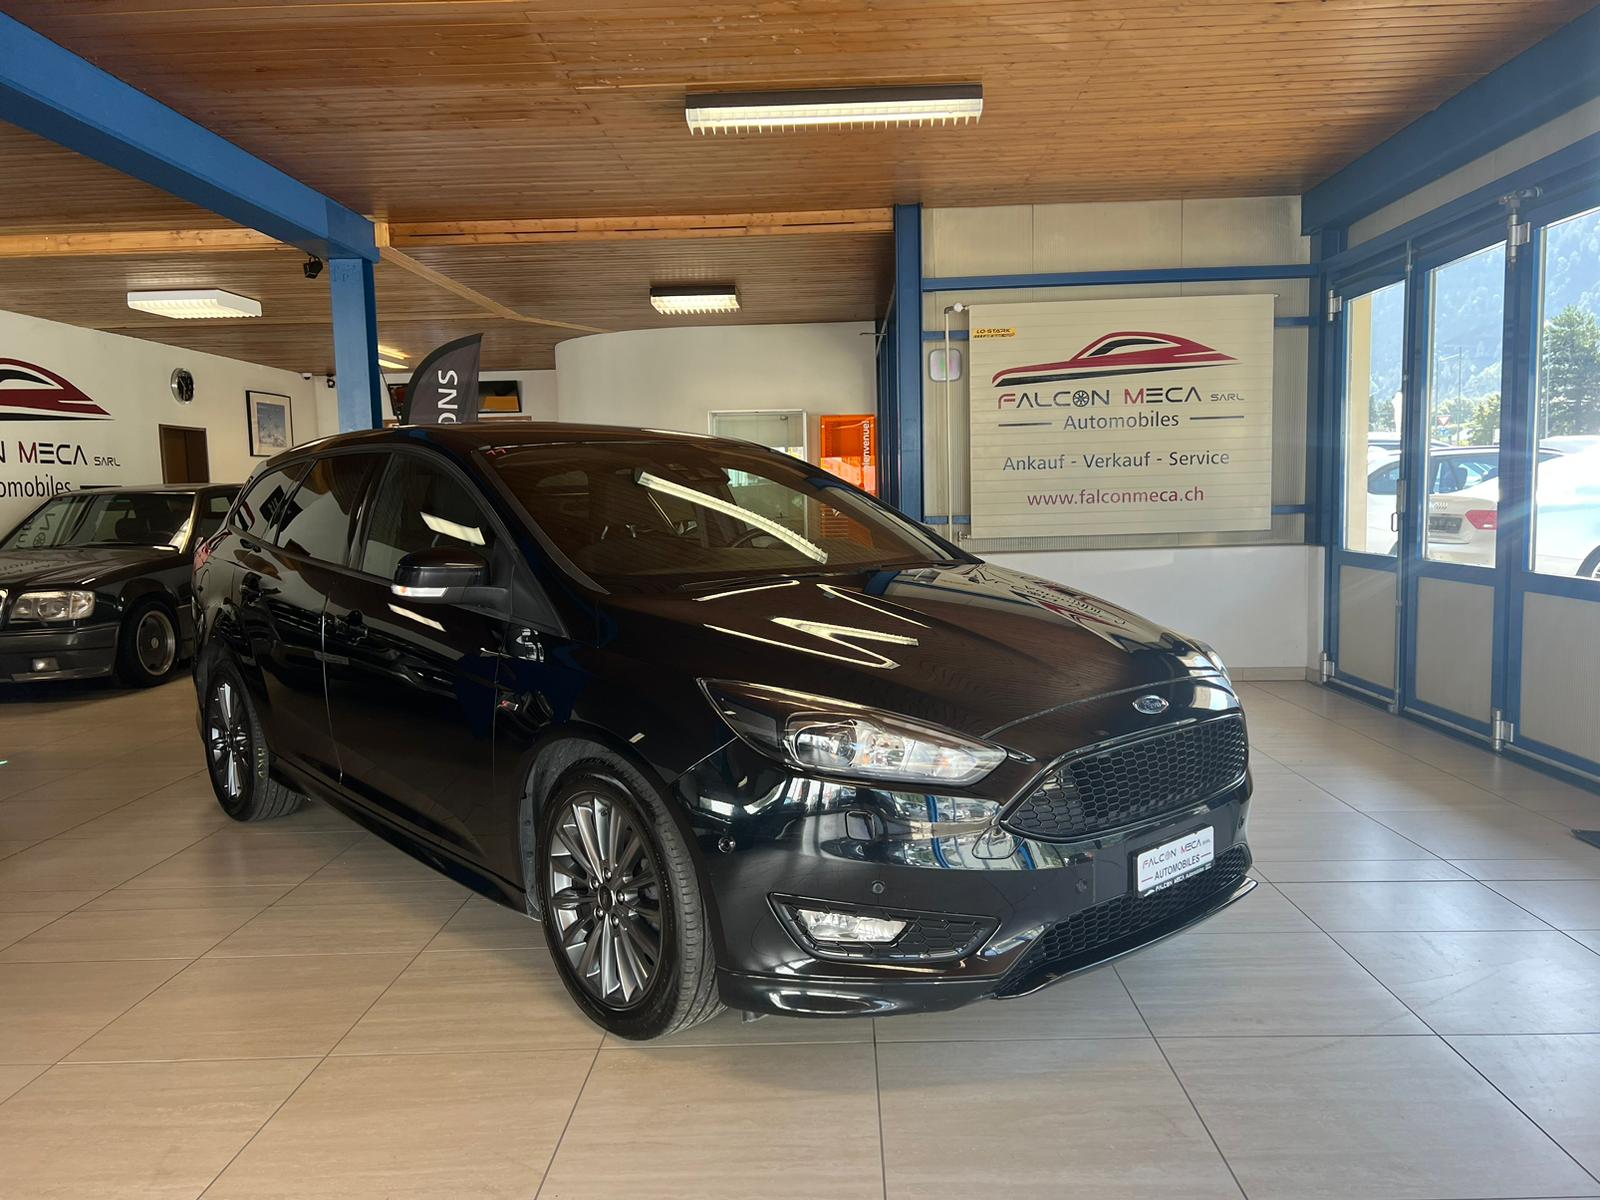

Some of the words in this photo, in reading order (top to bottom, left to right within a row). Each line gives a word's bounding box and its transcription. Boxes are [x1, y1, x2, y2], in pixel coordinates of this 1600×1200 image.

[998, 389, 1110, 409] FALCON
[1124, 386, 1202, 404] MECA
[1210, 393, 1244, 402] SARL
[1064, 410, 1179, 430] Automobiles
[18, 441, 88, 466] MECA
[94, 456, 120, 467] SARL
[1003, 454, 1065, 471] Ankauf
[1083, 451, 1151, 468] Verkauf
[1169, 450, 1230, 466] Service
[1027, 486, 1204, 506] www.falconmeca.ch
[1154, 854, 1200, 880] AUTOMOBILES
